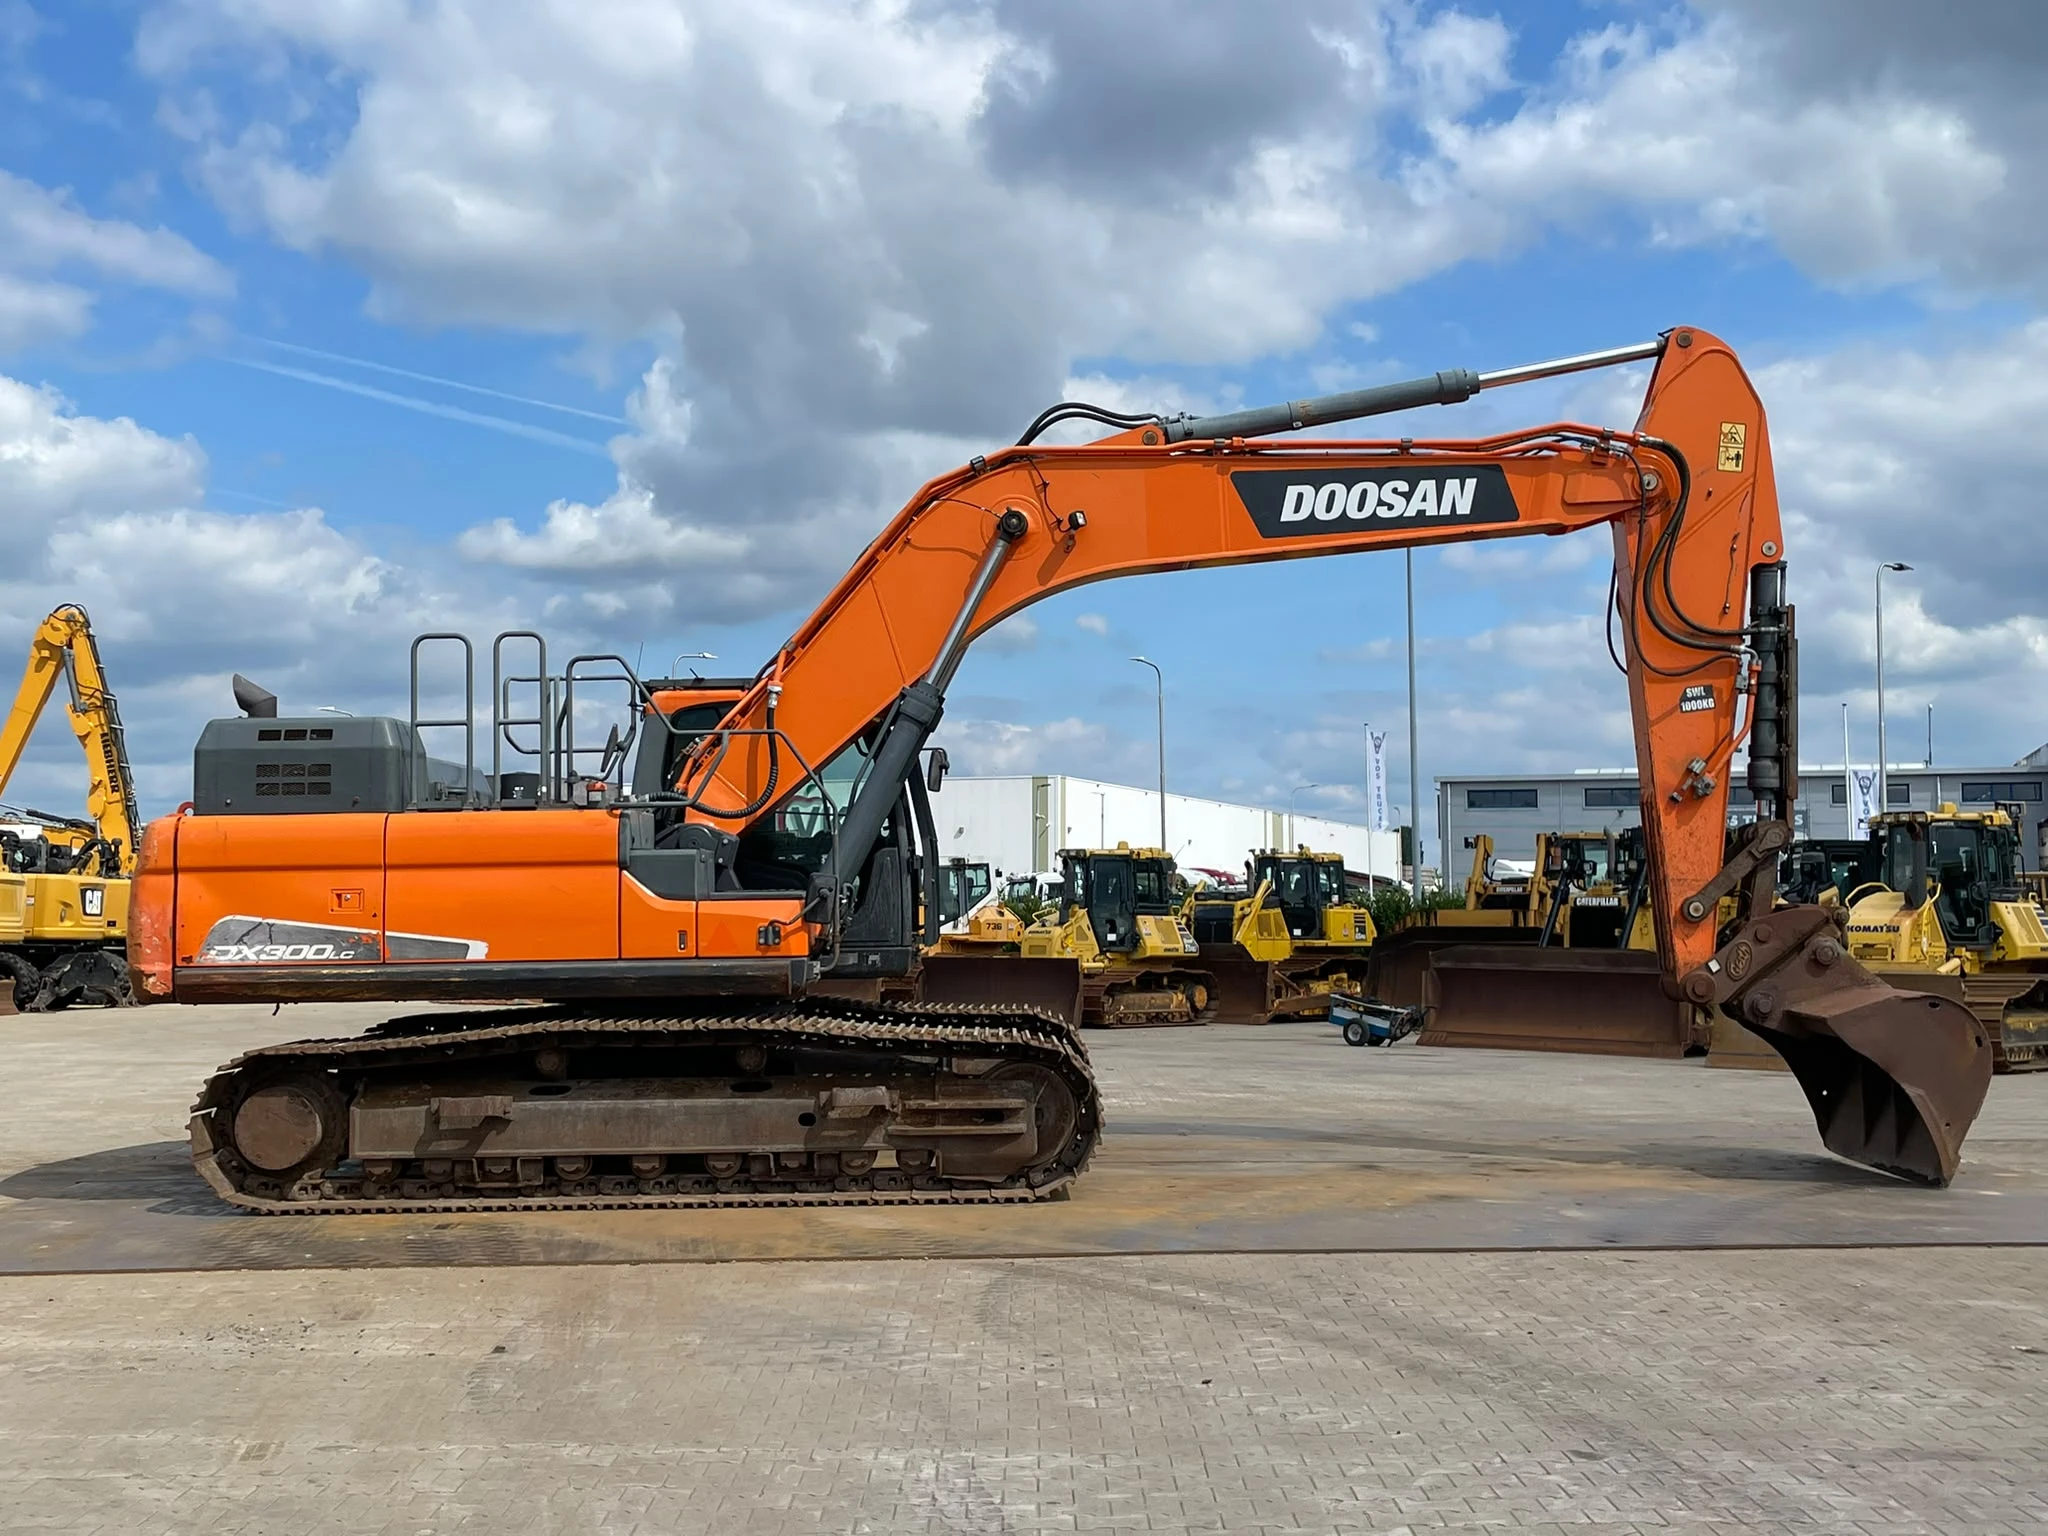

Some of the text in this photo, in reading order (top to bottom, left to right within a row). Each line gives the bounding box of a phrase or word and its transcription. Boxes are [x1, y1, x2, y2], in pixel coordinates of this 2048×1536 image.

[1280, 478, 1477, 522] DOOSAN
[1686, 686, 1706, 698] SWL
[1681, 698, 1715, 711] 1000KG
[100, 732, 120, 794] LIEBHERR
[85, 889, 103, 915] CAT
[1576, 896, 1619, 907] CATERPILLAR
[1846, 923, 1900, 933] KOMATSU
